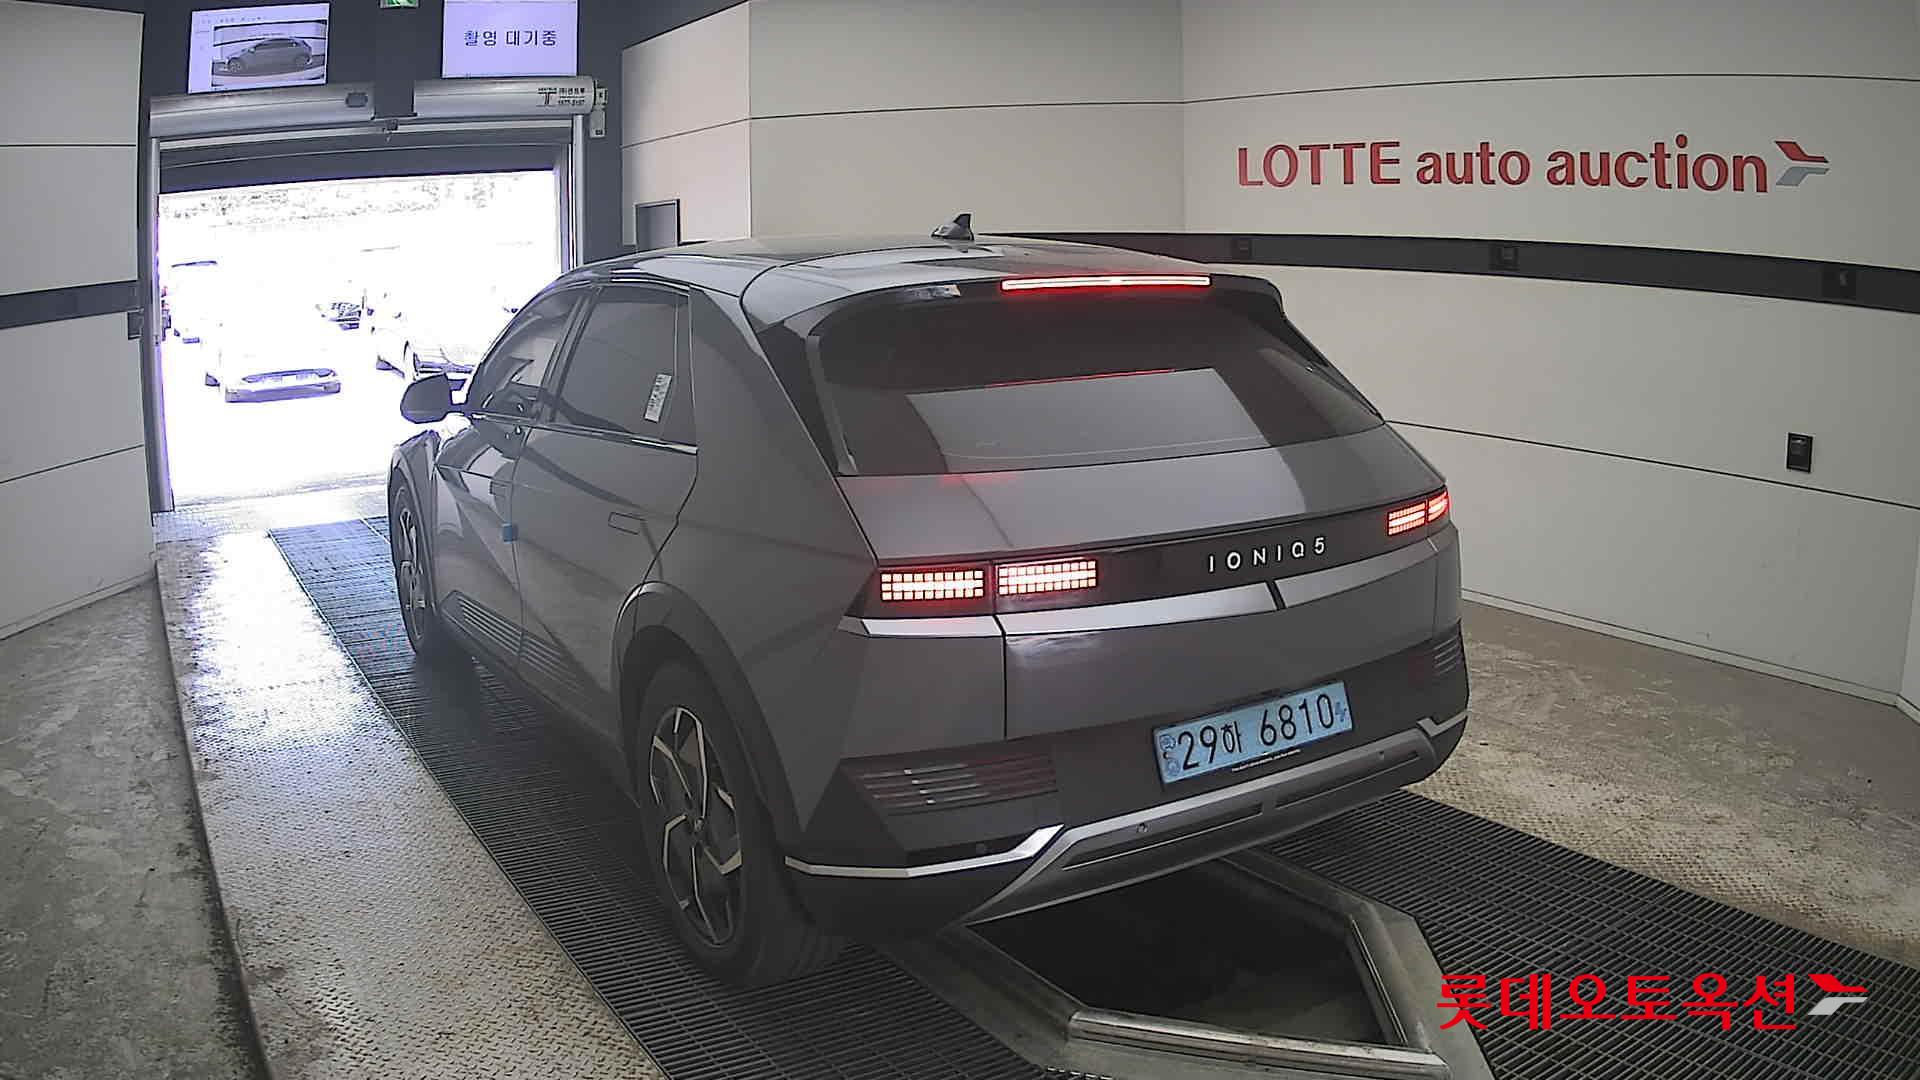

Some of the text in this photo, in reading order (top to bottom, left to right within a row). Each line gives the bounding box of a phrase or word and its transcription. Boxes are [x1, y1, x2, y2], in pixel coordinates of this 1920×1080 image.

[464, 30, 558, 47] 촬영 대기중
[1237, 134, 1768, 193] LOTTE auto auction
[1177, 721, 1243, 771] 29하
[1260, 693, 1335, 746] 6810
